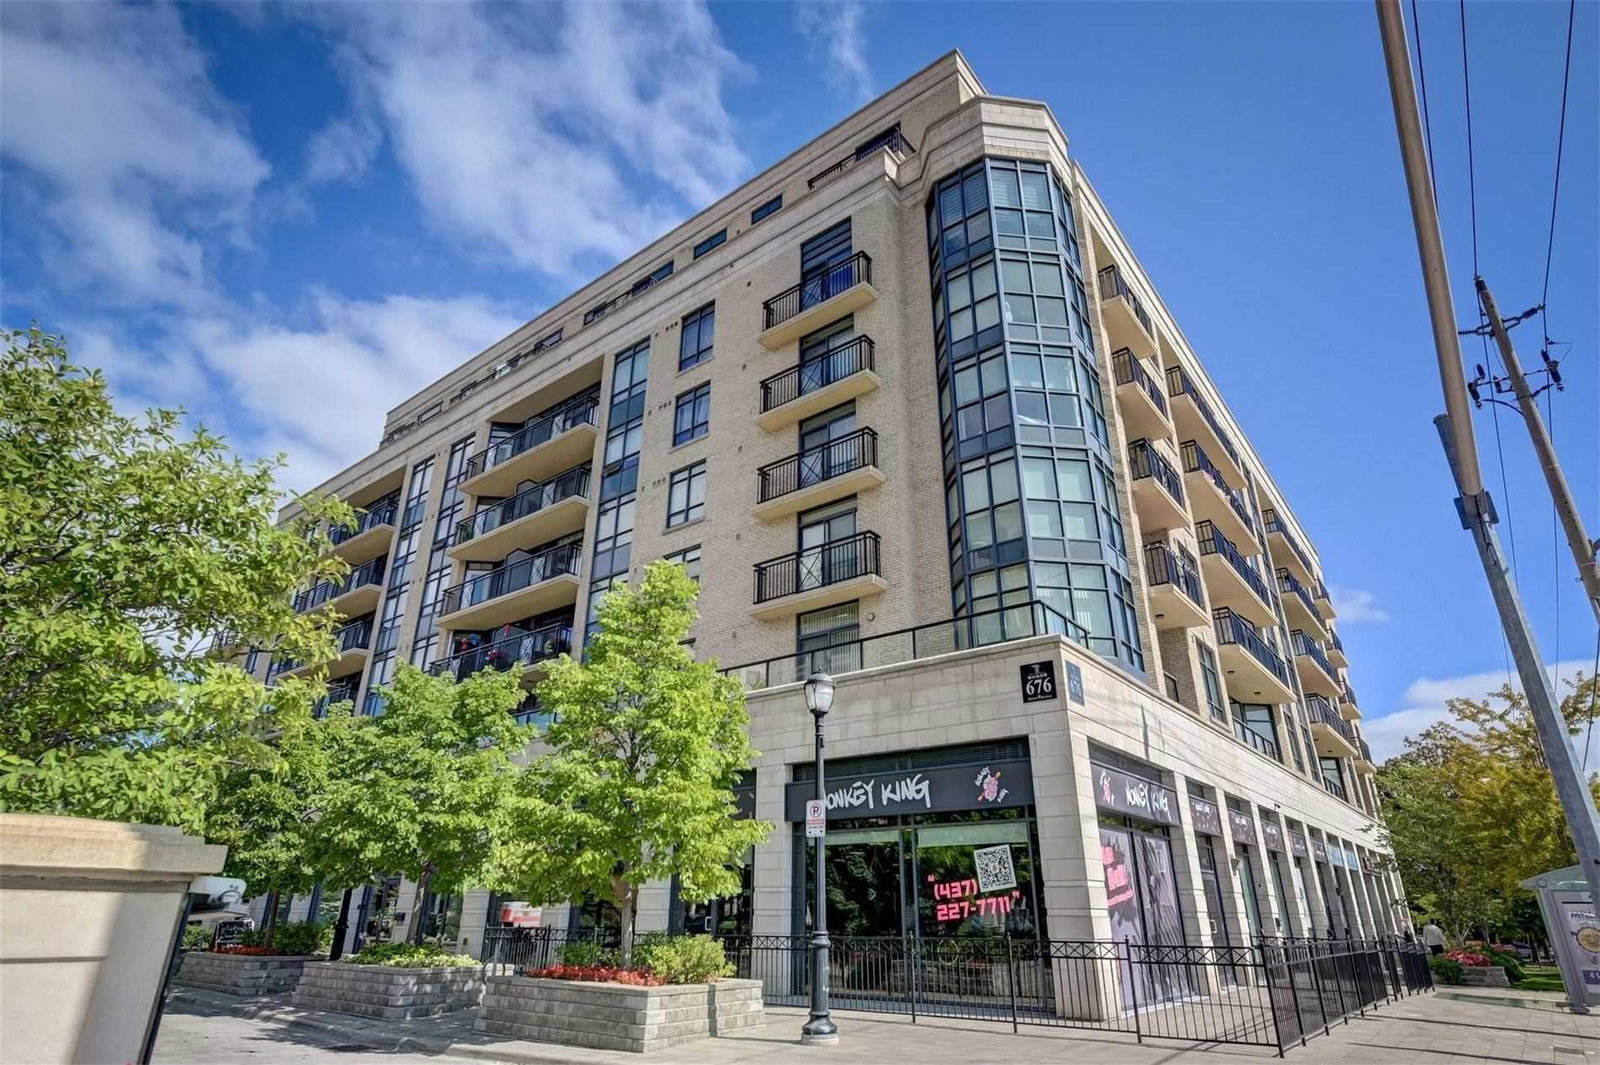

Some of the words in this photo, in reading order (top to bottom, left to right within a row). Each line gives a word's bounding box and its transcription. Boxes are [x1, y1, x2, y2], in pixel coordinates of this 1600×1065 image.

[1026, 676, 1052, 695] 676
[823, 779, 875, 810] ONKEY
[881, 773, 930, 809] KING
